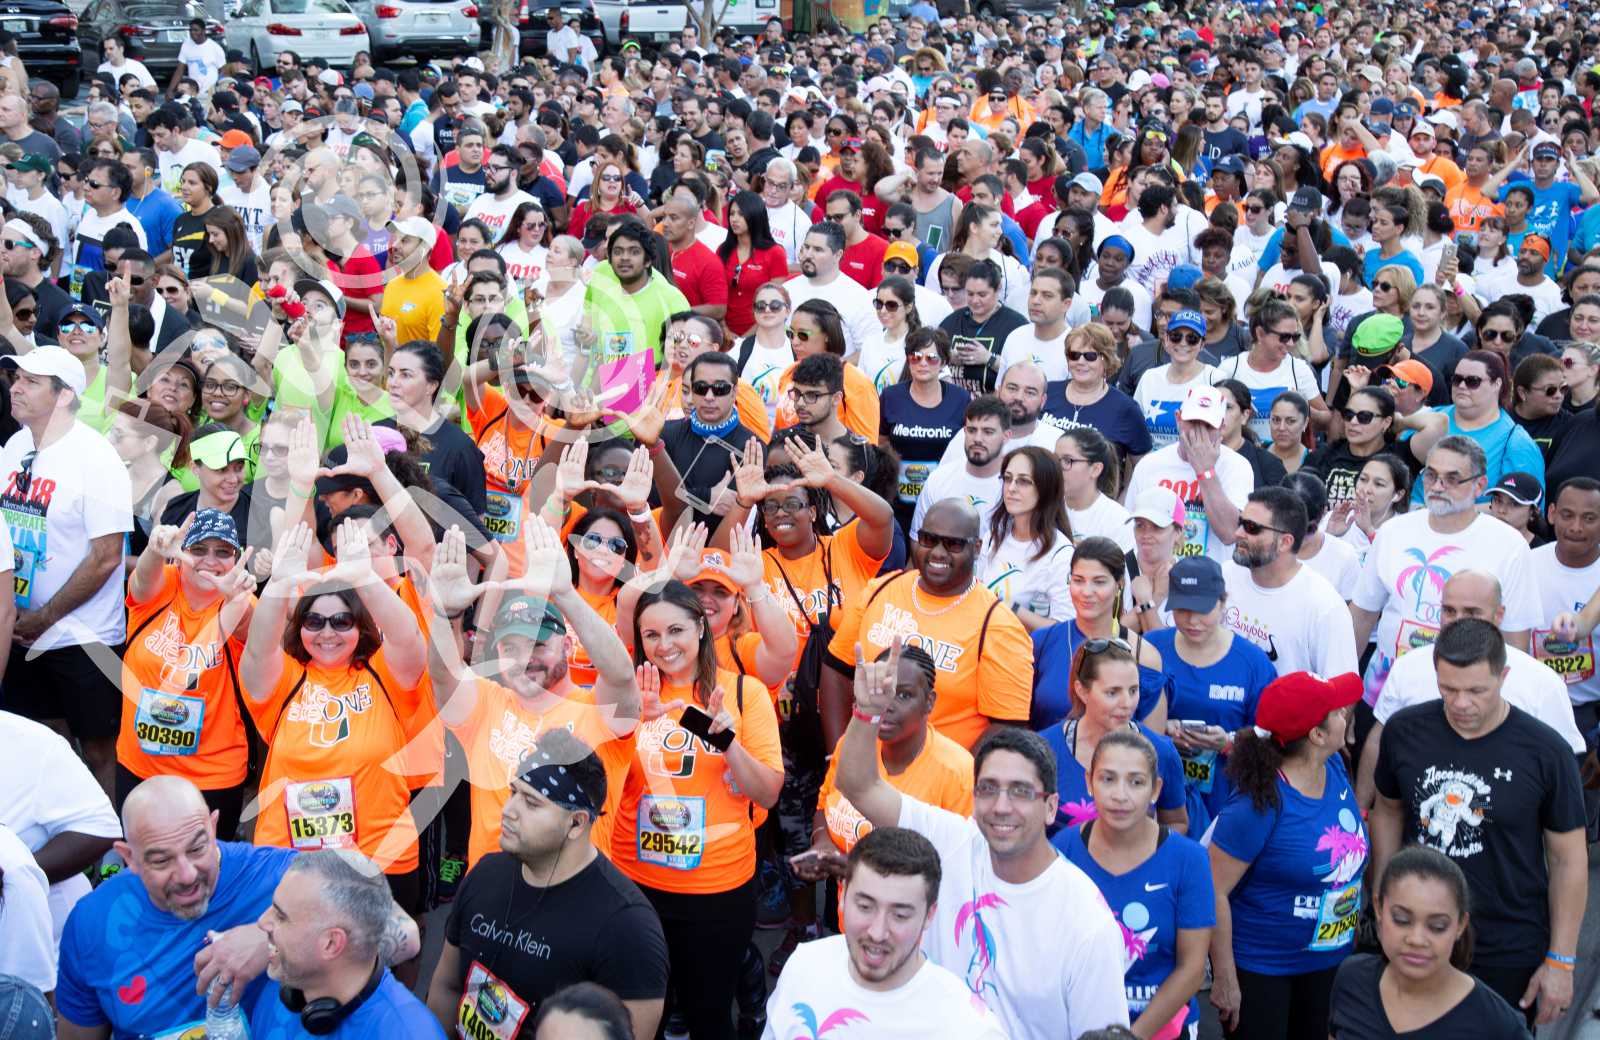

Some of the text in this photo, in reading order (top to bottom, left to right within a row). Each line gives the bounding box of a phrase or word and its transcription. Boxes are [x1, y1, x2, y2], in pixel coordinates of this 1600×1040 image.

[892, 423, 953, 439] Medtronic
[2, 470, 57, 506] 218
[321, 684, 372, 723] ONE
[136, 722, 196, 748] 30390
[291, 812, 354, 839] 15373
[639, 831, 701, 856] 29542
[470, 912, 552, 961] Calvin Klein
